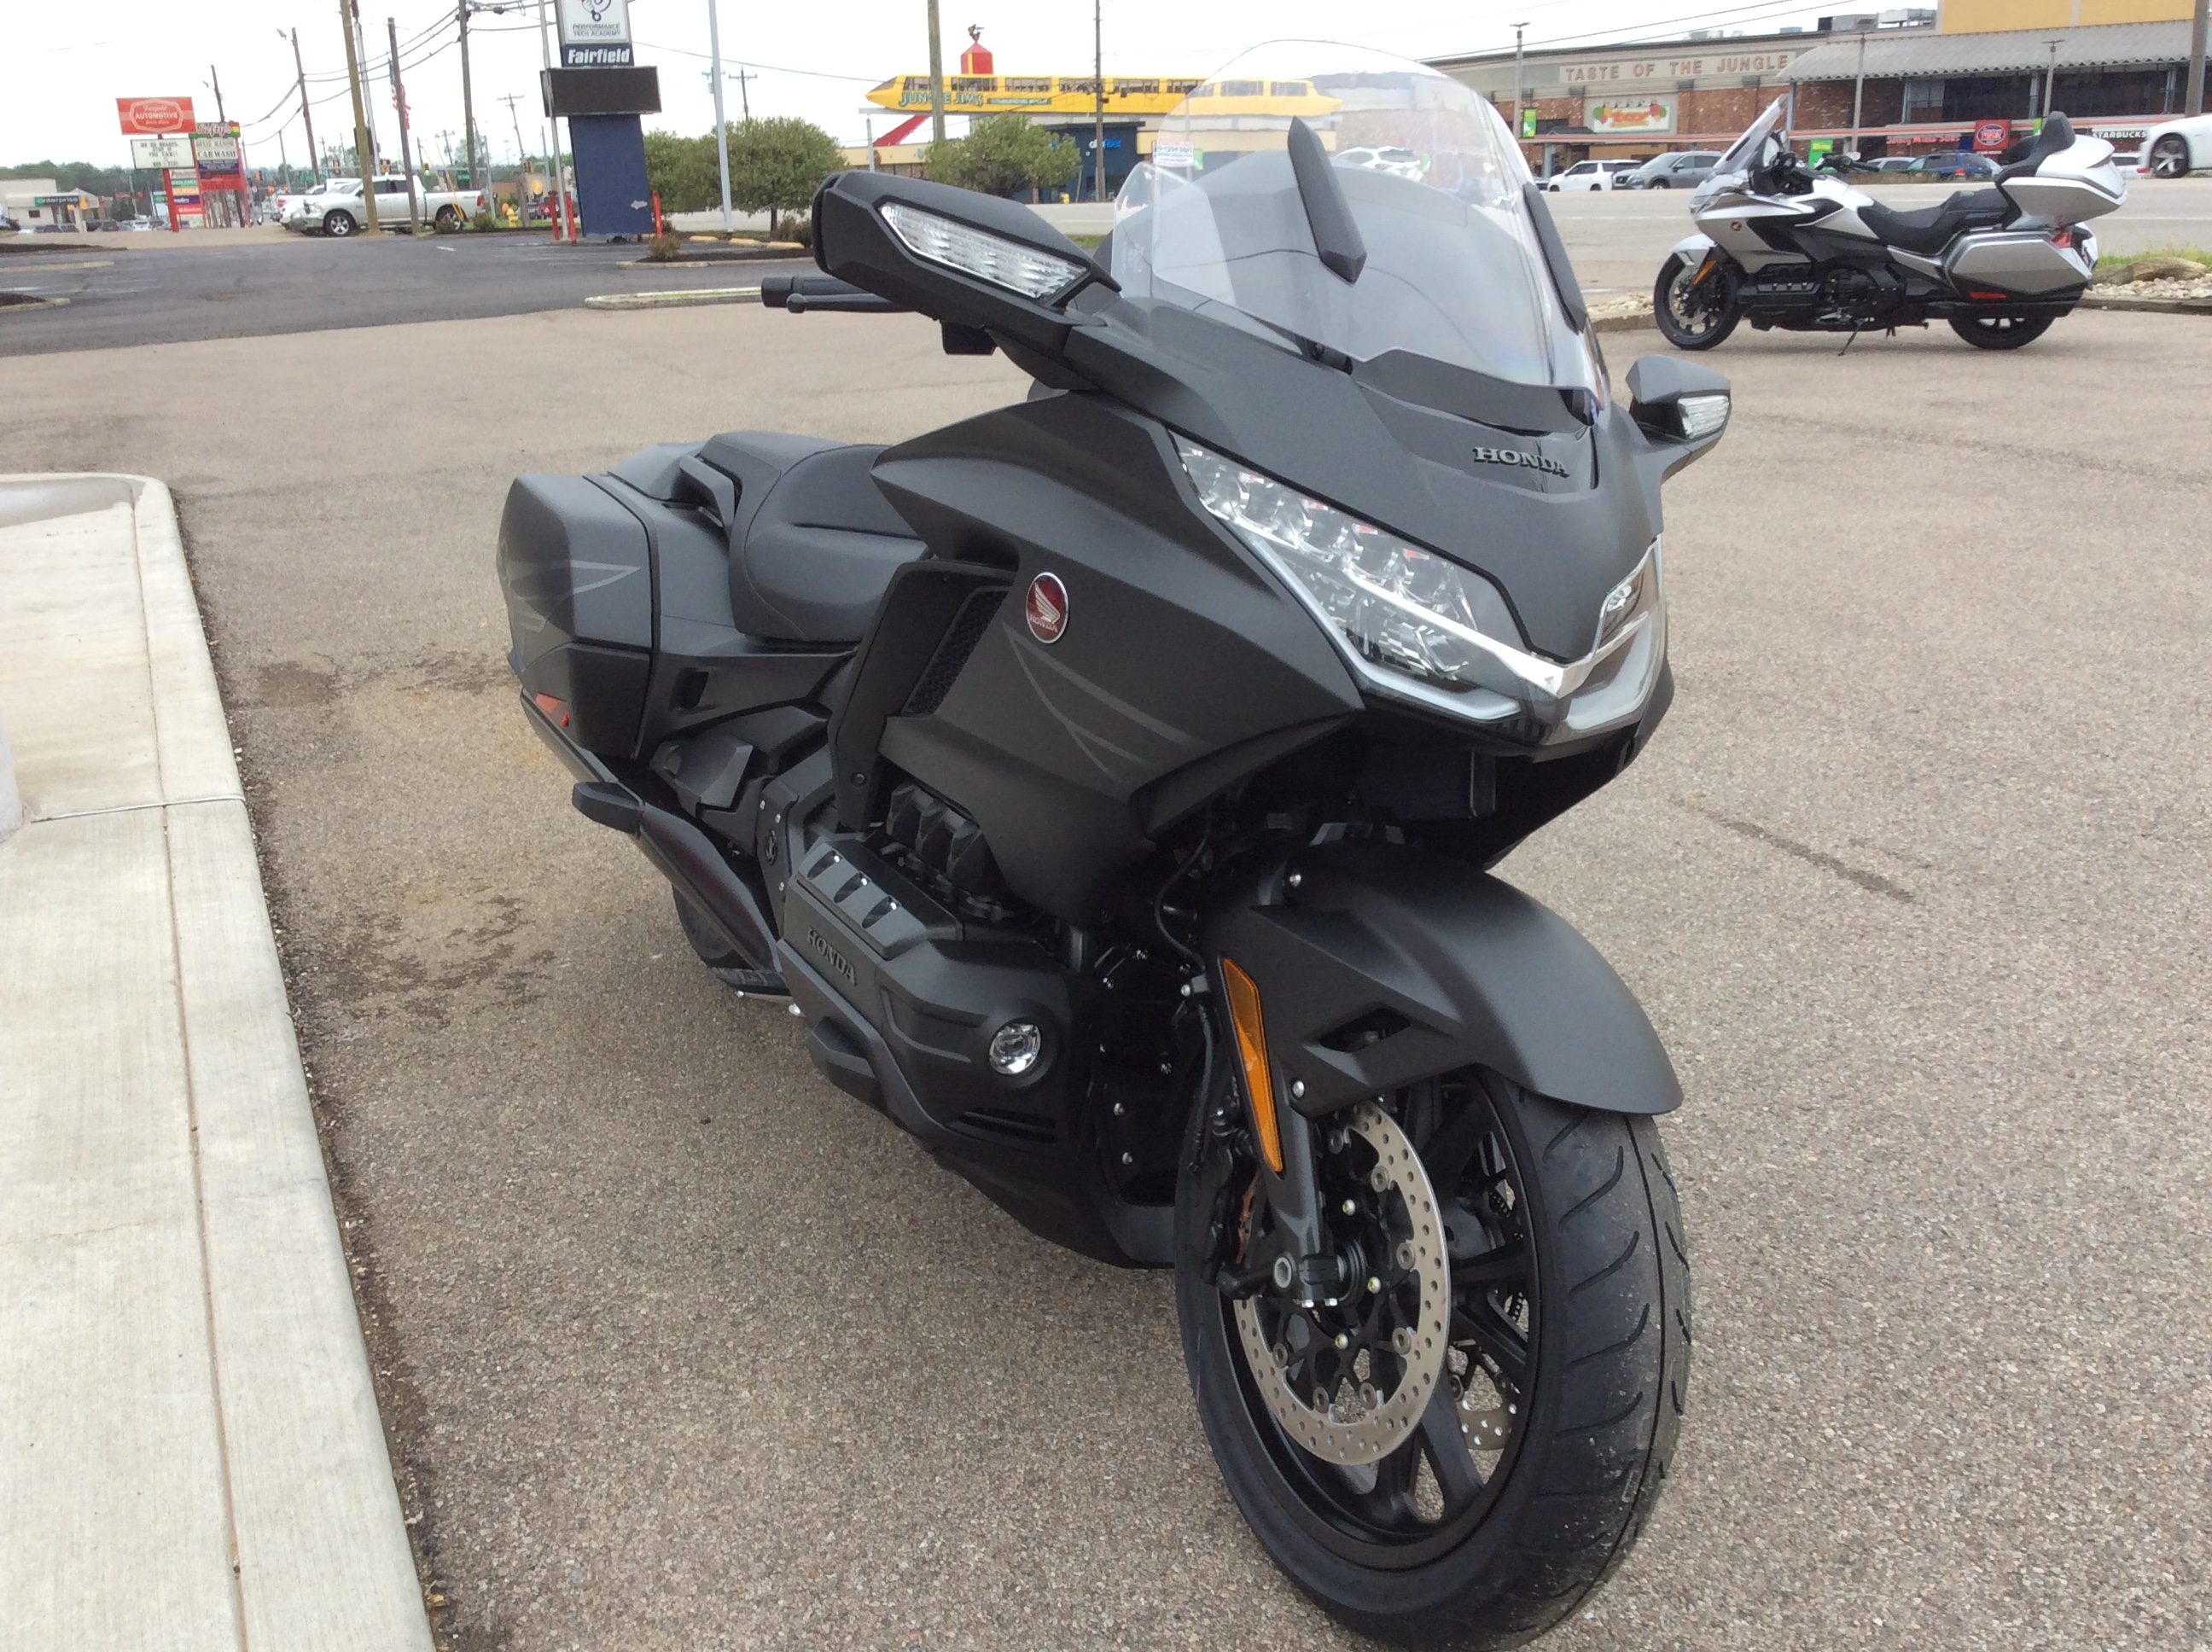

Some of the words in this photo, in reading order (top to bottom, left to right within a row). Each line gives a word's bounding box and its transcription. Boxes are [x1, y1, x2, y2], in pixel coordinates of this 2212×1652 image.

[568, 48, 631, 64] Fairfield
[1565, 65, 1620, 82] TASTE
[1633, 63, 1655, 78] OF
[1669, 60, 1703, 75] THE
[1717, 55, 1789, 73] JUNGLE
[1472, 446, 1570, 479] HONDA
[1029, 614, 1058, 633] HONDA
[807, 926, 857, 986] HONDA
